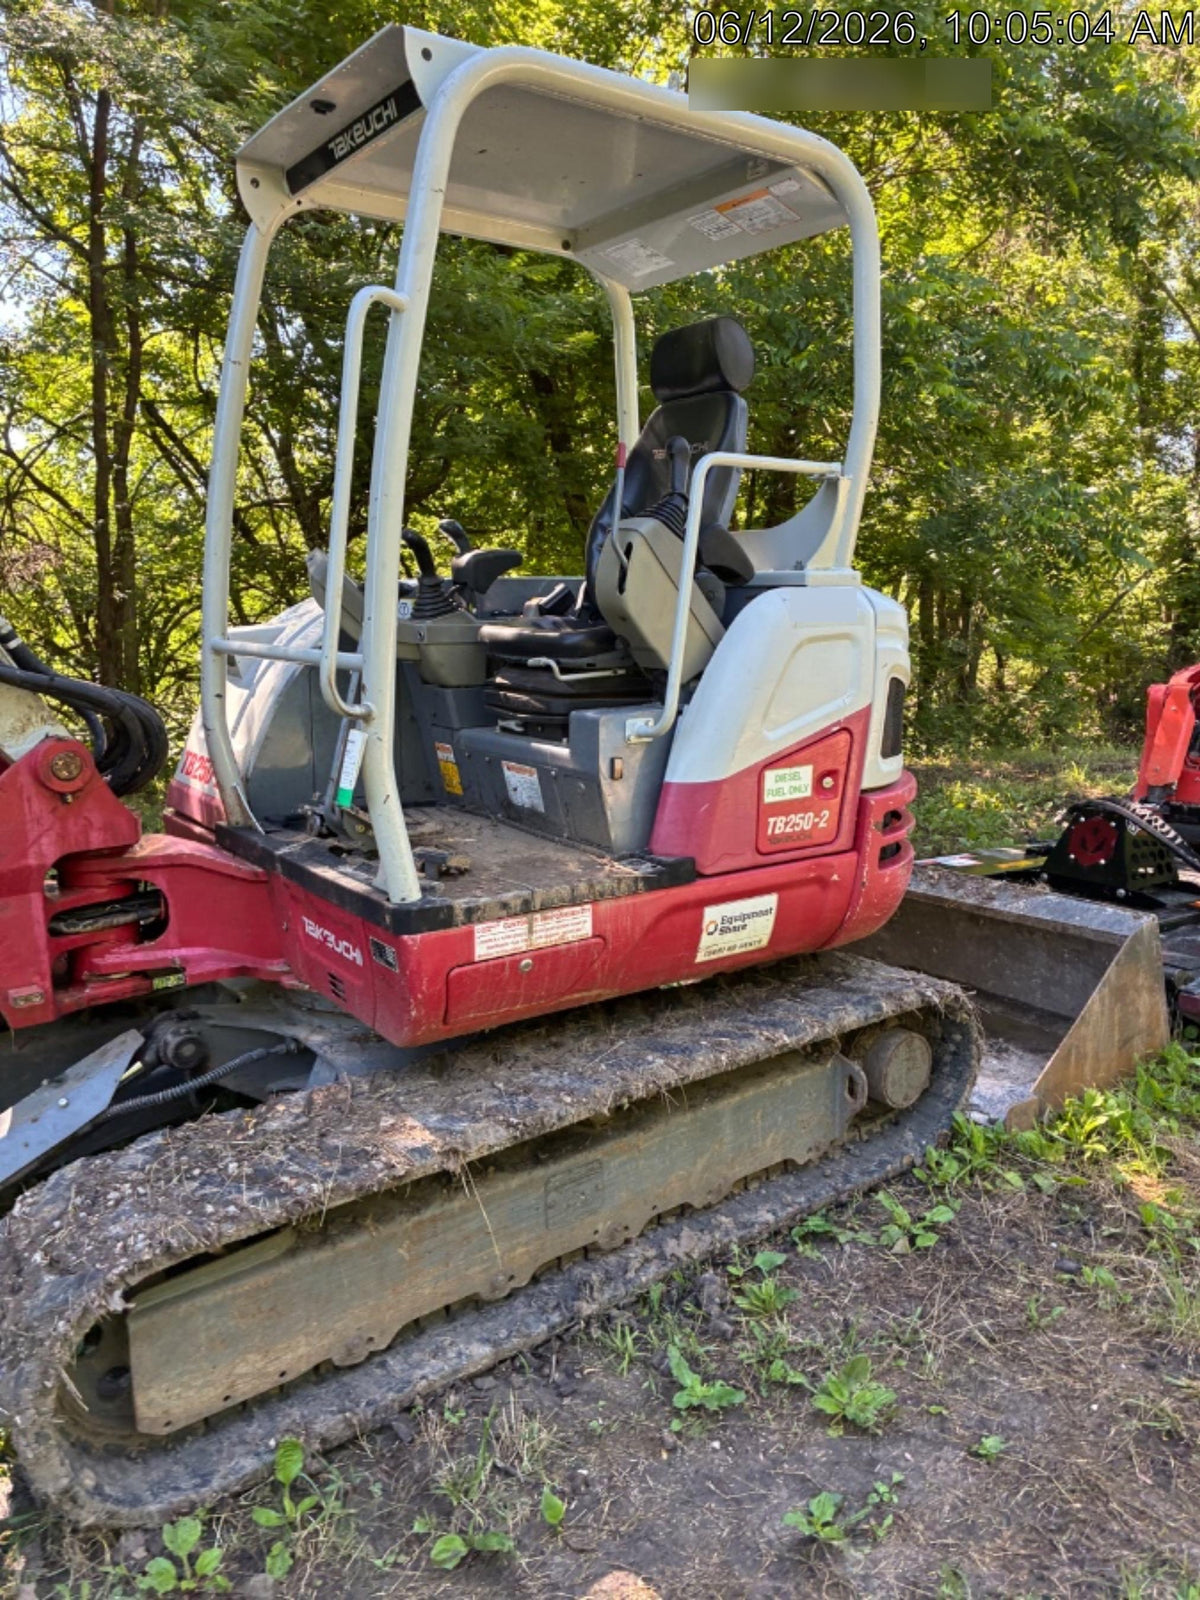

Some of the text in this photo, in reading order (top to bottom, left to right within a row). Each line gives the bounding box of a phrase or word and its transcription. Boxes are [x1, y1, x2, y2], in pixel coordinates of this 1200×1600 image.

[775, 771, 801, 783] DIESEL
[767, 783, 809, 798] FUEL ONLY
[767, 810, 829, 835] TB250-2
[721, 907, 773, 925] Equipment
[718, 923, 748, 935] Share
